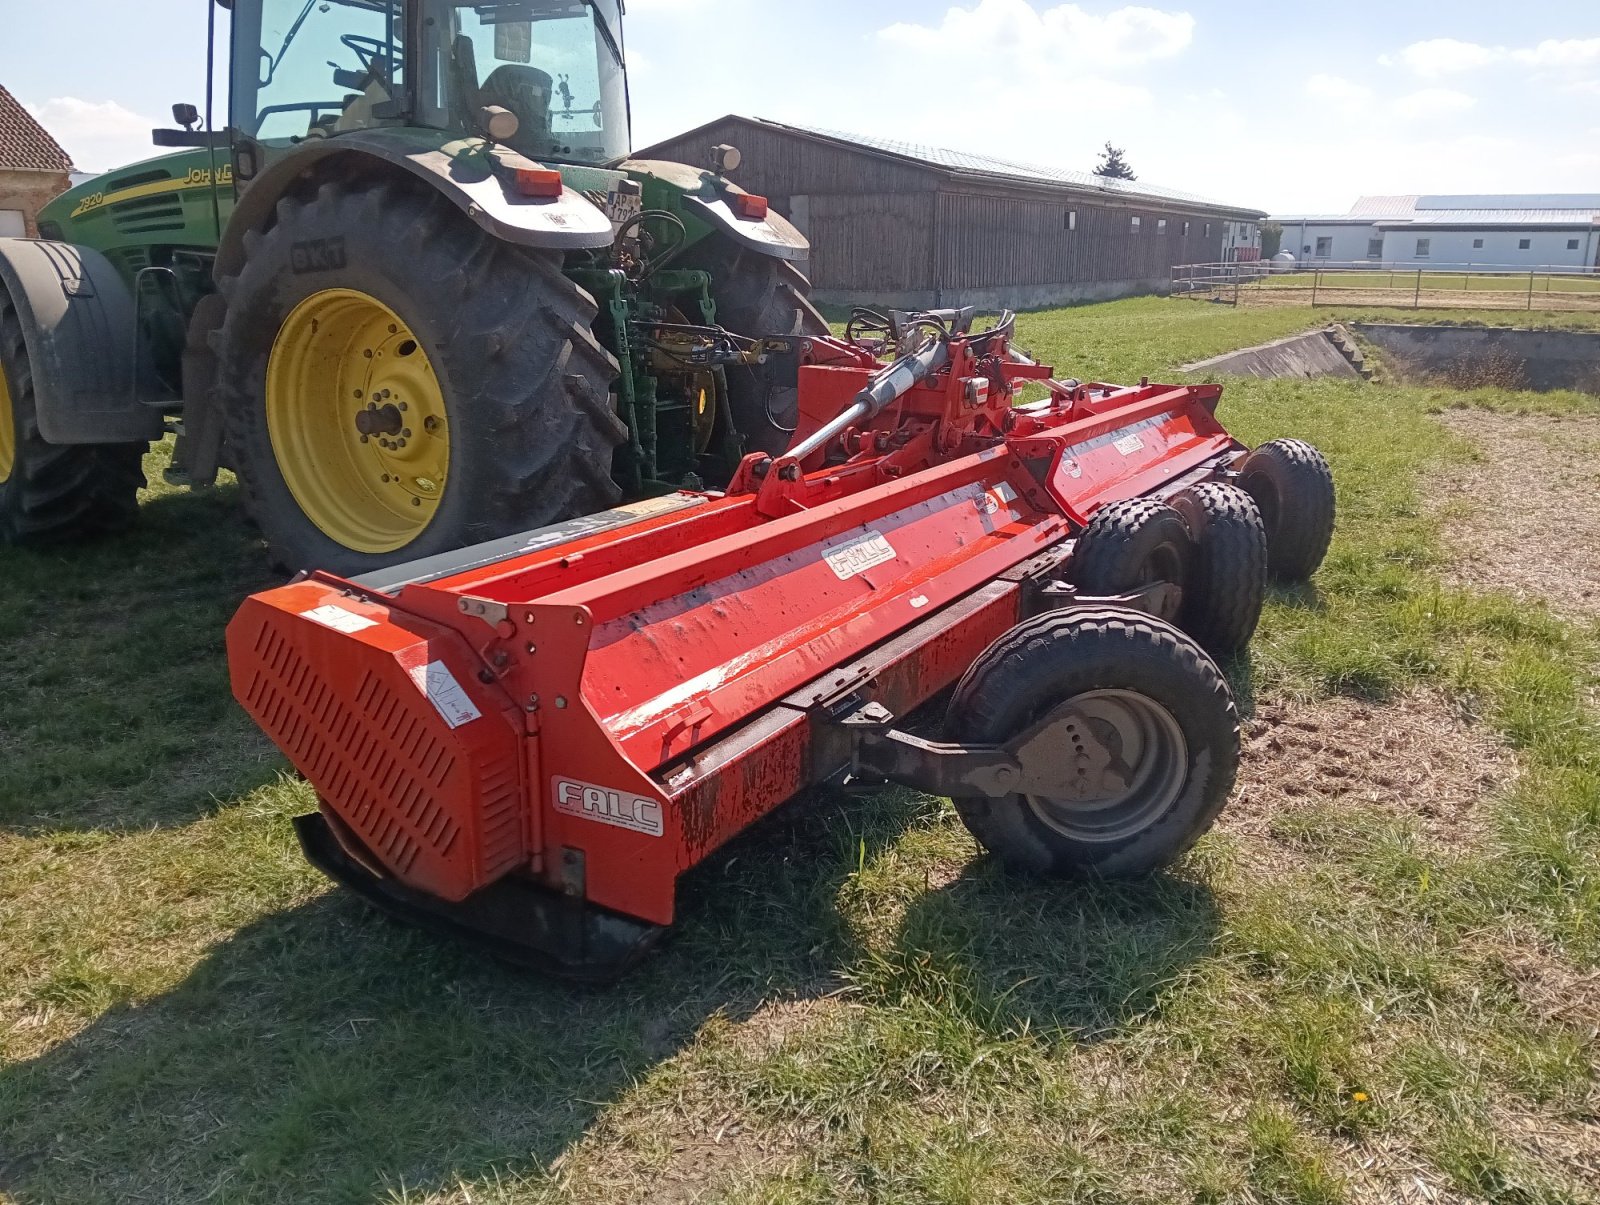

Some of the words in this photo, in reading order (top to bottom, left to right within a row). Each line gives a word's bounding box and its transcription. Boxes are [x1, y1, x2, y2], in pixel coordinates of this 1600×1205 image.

[184, 167, 221, 184] JOHN
[80, 191, 102, 211] 7920
[615, 194, 627, 207] AP
[292, 240, 343, 270] BKT
[828, 533, 890, 573] FALC
[558, 781, 659, 829] FALC
